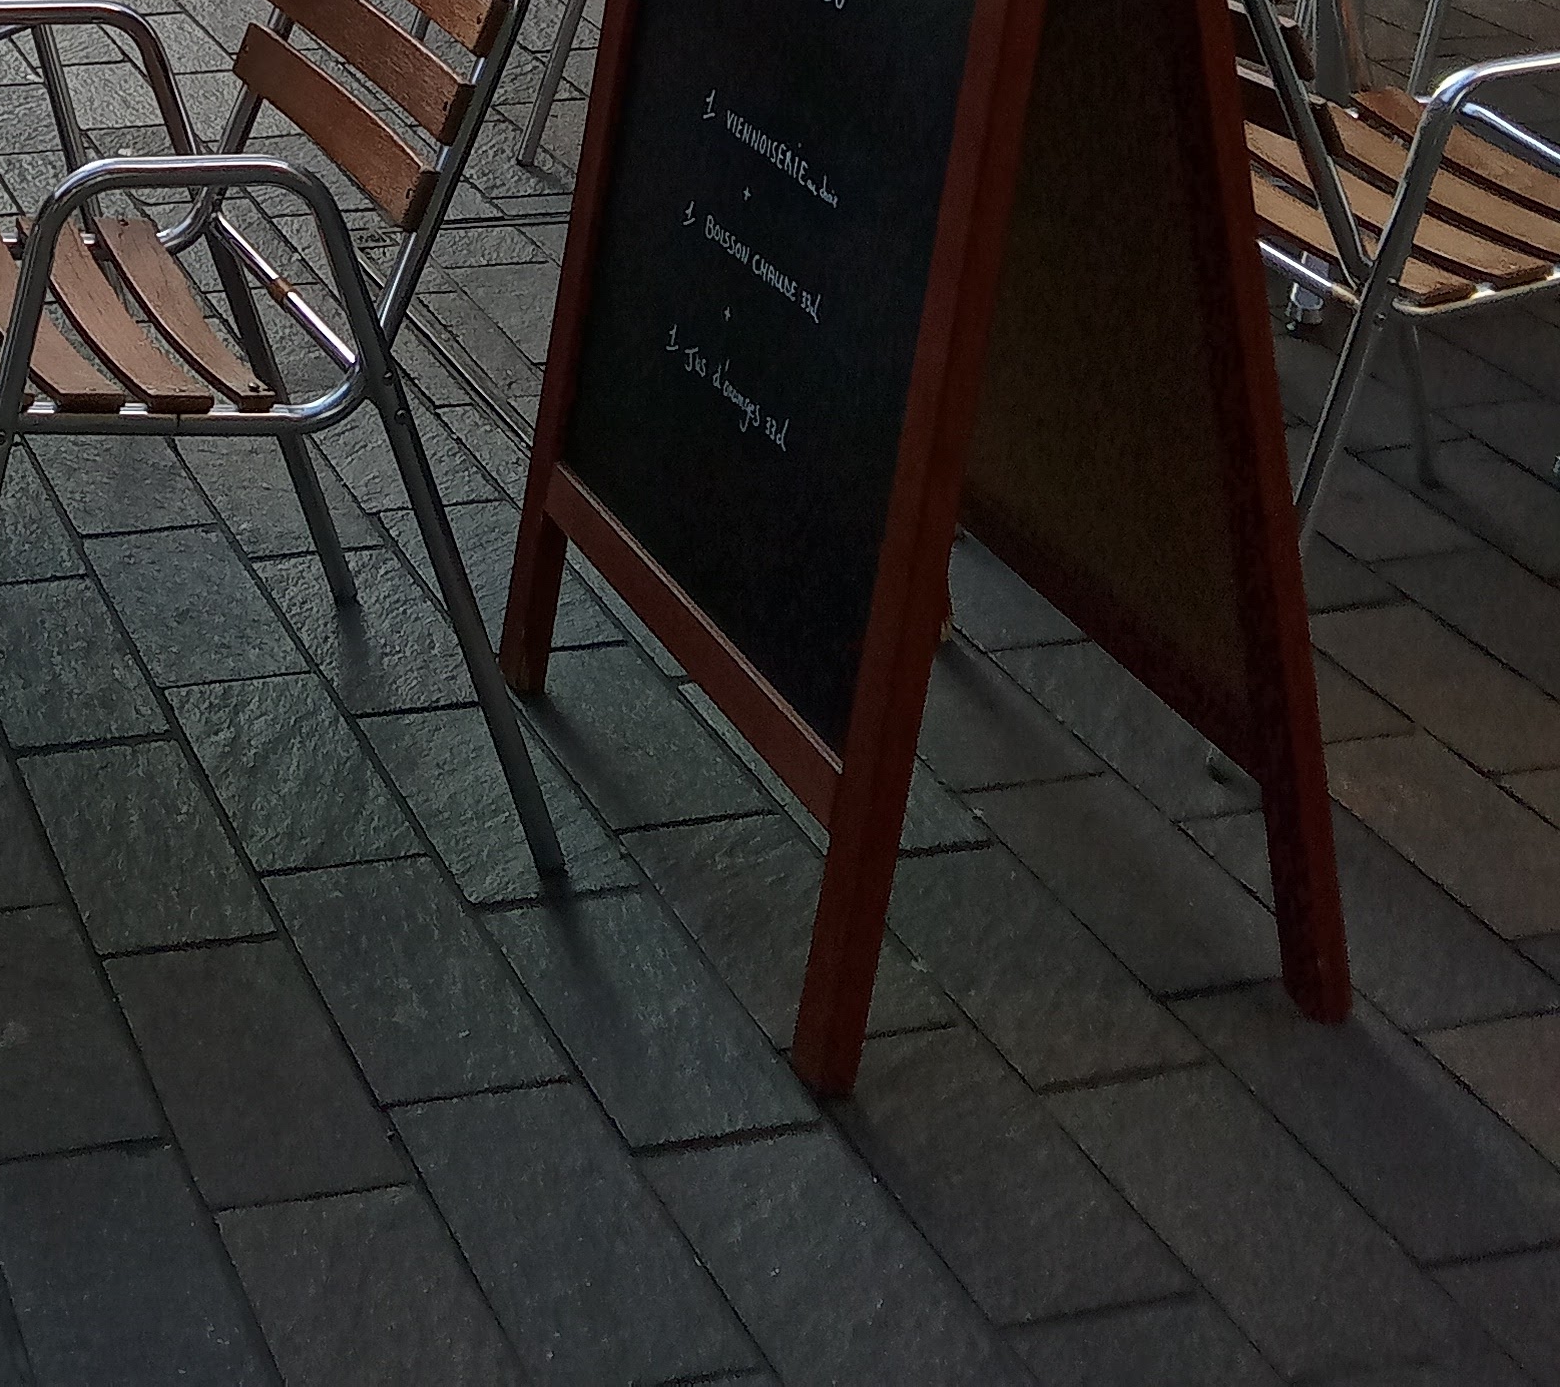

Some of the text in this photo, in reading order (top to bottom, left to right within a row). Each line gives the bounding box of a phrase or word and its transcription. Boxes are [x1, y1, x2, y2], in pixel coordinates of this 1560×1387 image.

[702, 88, 716, 119] 1
[726, 109, 810, 186] VIENNOISERIE
[682, 200, 696, 226] 1
[704, 214, 750, 265] BOISSON
[752, 254, 798, 302] CHAUDE
[665, 323, 679, 351] 1
